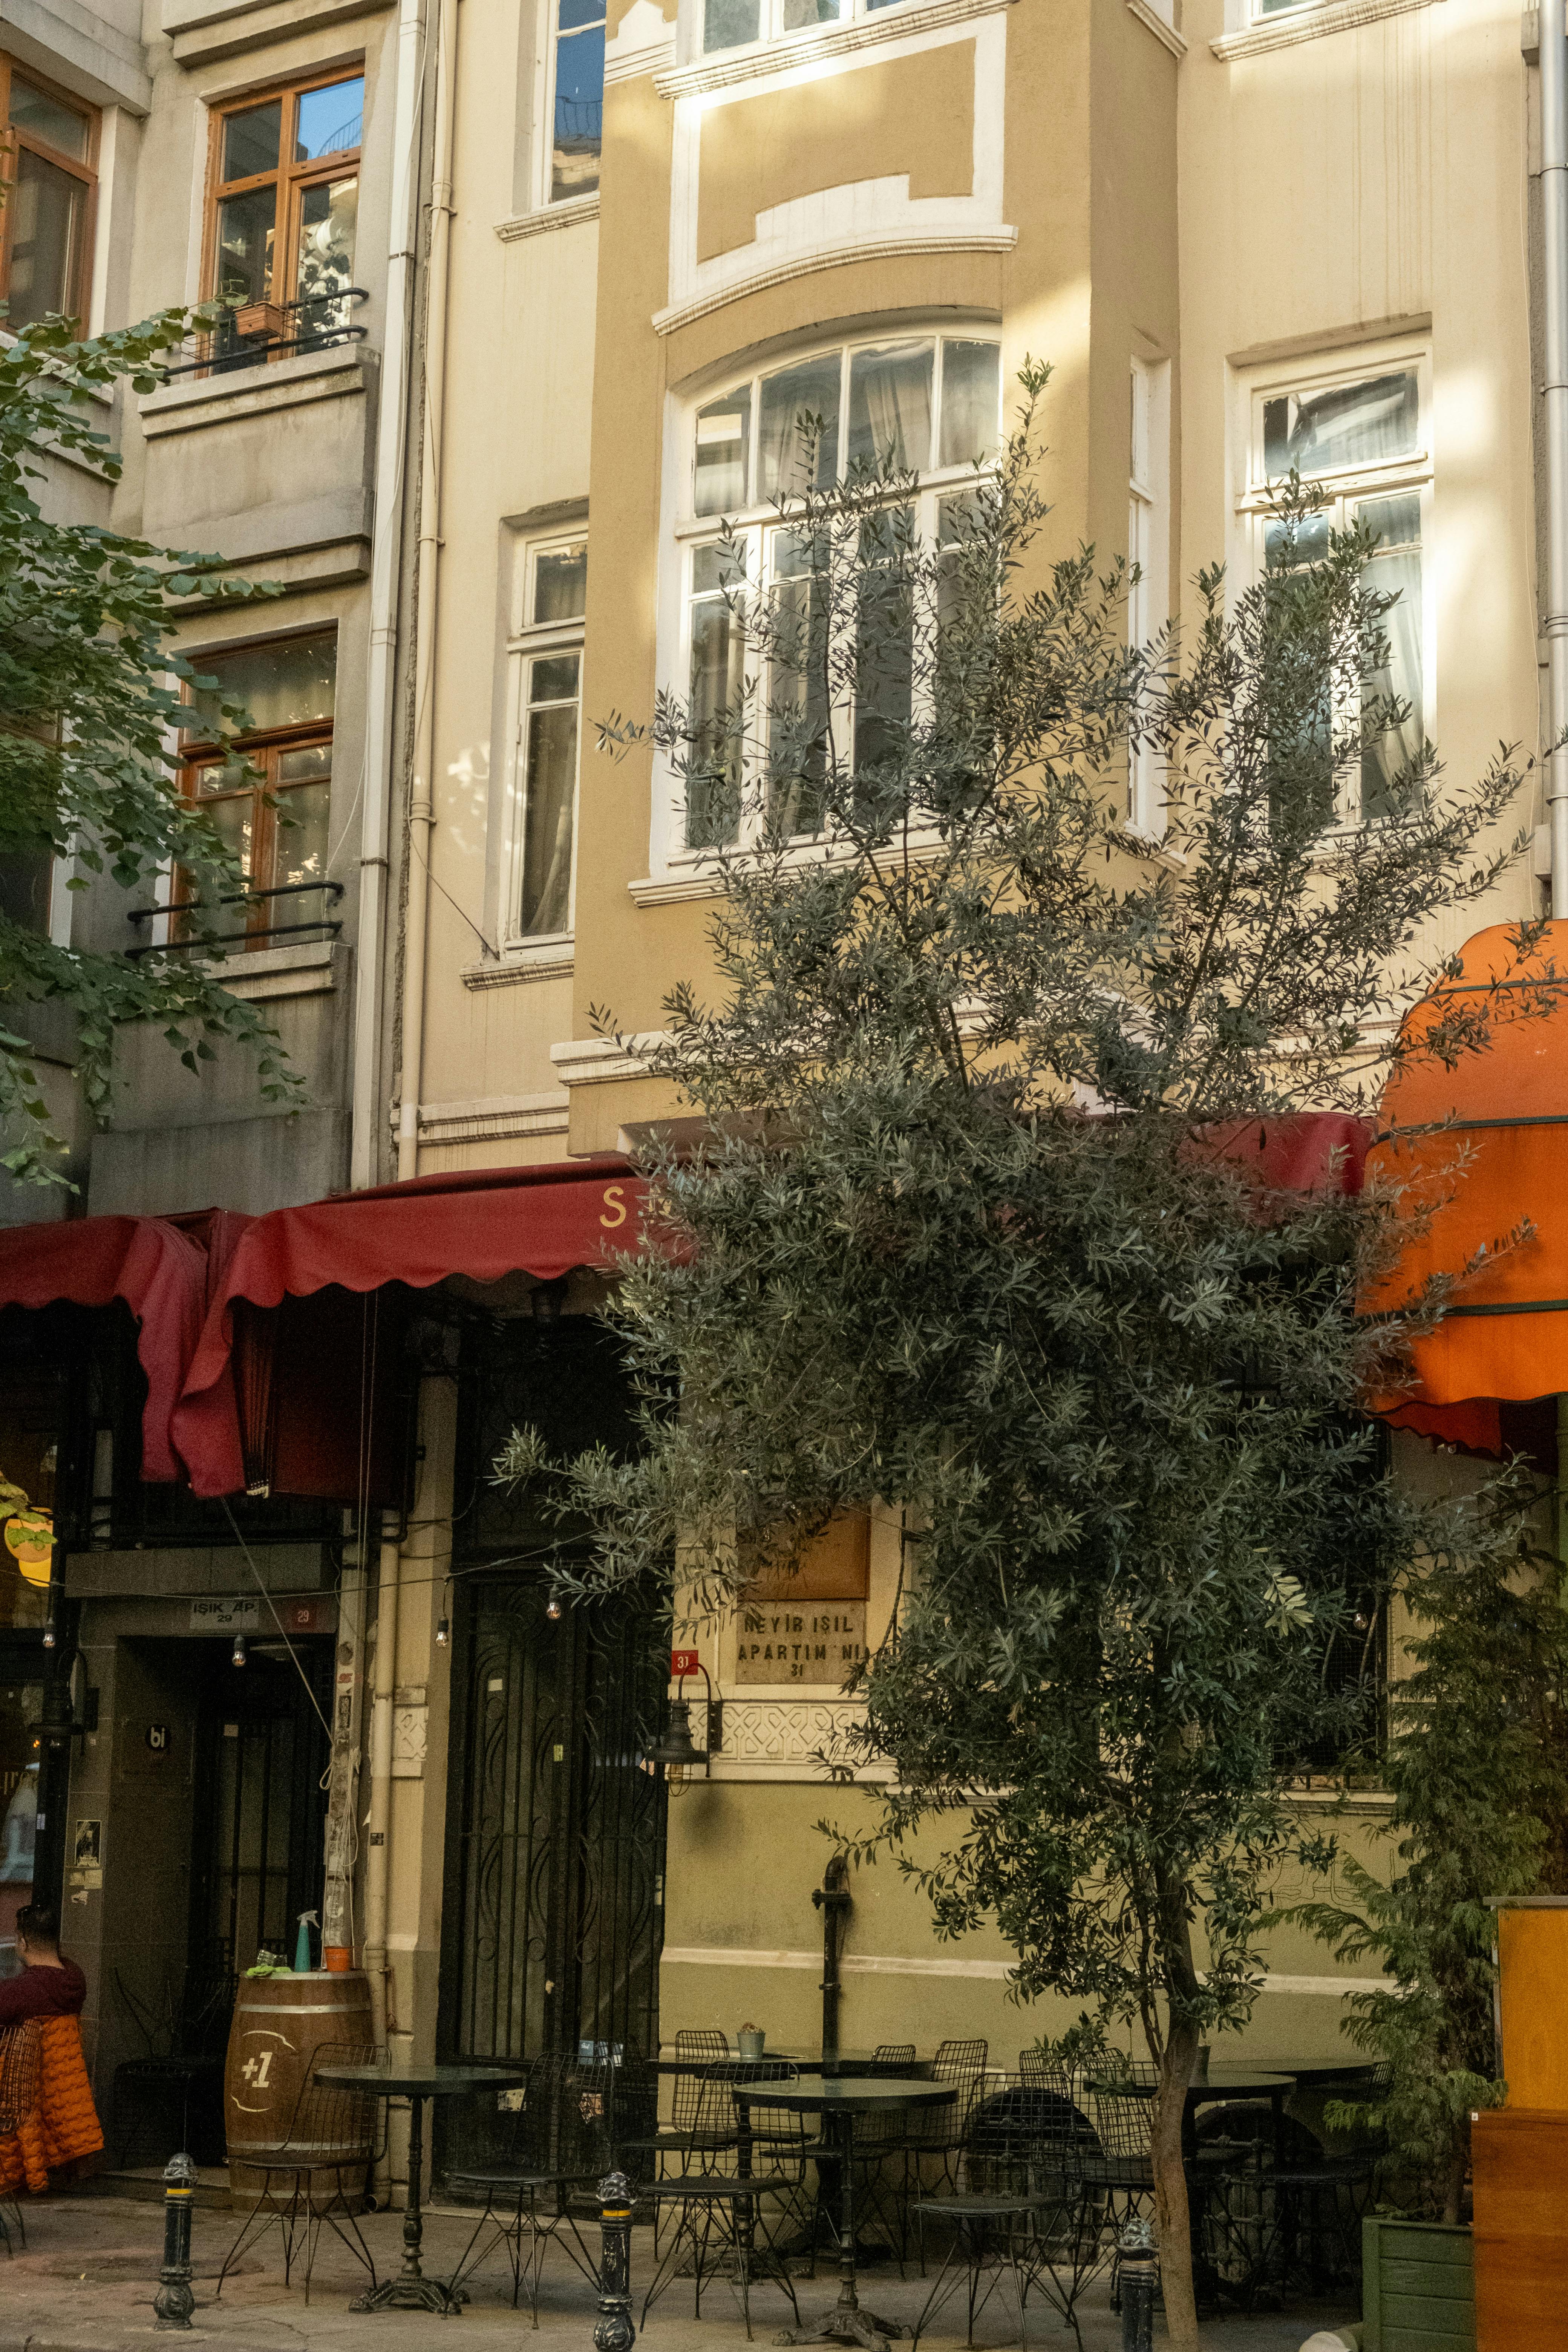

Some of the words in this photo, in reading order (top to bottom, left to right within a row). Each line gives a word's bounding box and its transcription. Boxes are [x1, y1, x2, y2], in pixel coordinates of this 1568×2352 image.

[193, 1602, 224, 1615] IŞIK
[297, 1610, 309, 1623] 29
[813, 1616, 853, 1634] IŞIL
[677, 1656, 689, 1669] 31
[791, 1663, 803, 1677] 31
[150, 1726, 165, 1748] bi
